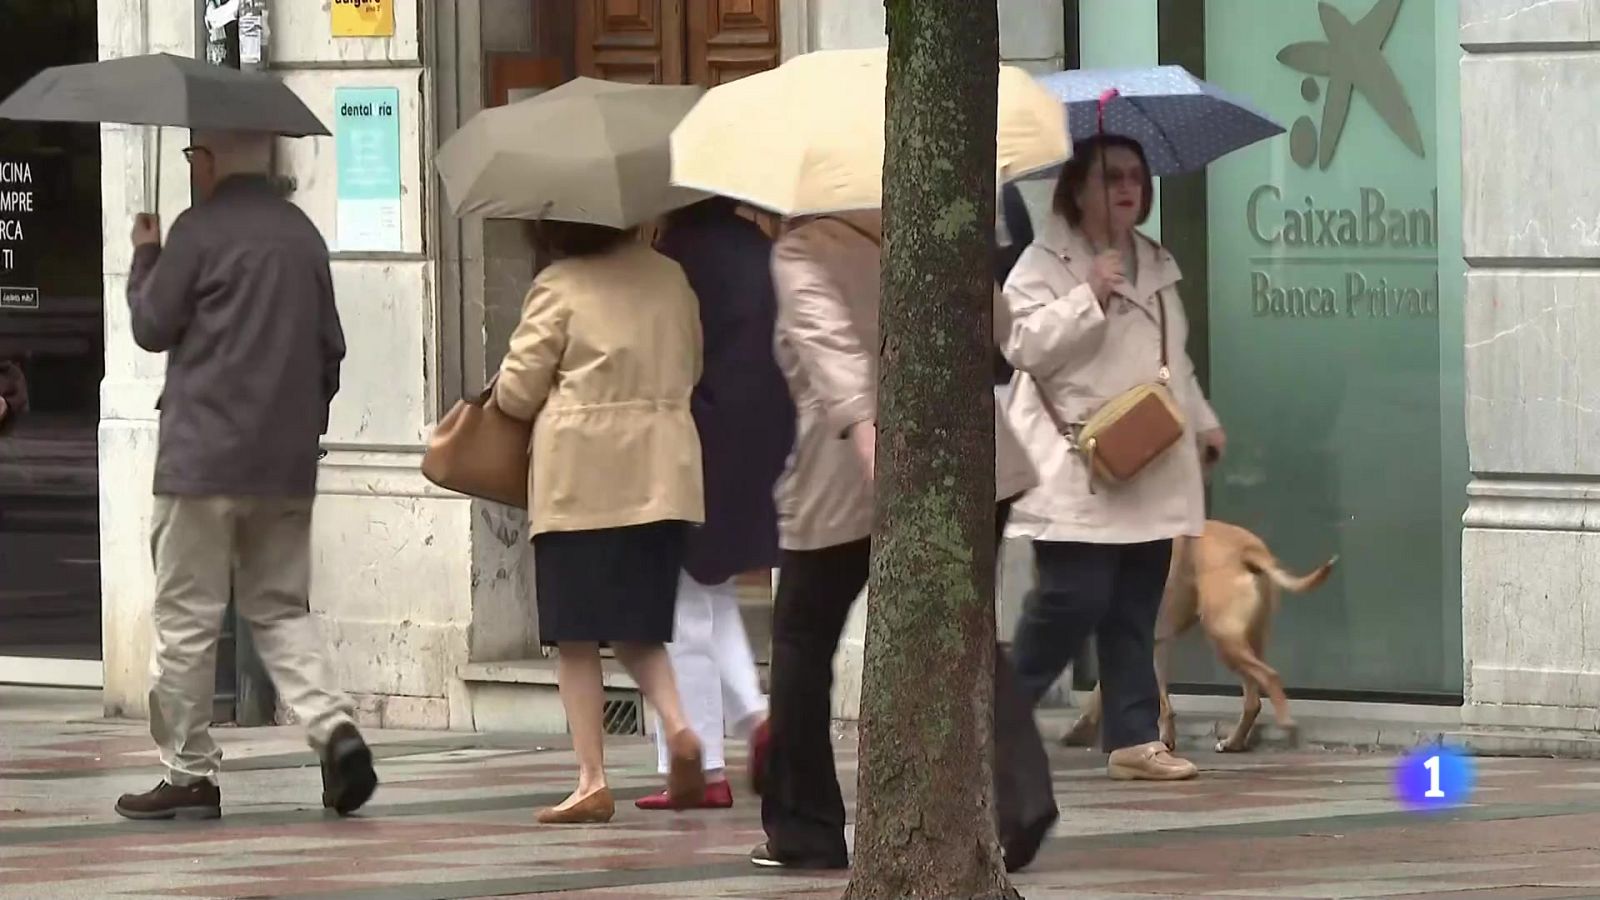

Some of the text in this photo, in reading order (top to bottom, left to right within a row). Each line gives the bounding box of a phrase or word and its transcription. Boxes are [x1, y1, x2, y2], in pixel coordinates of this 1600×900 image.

[340, 101, 373, 117] dental
[1247, 184, 1438, 247] CaixaBan
[2, 248, 14, 270] TI
[1250, 271, 1339, 318] Banca
